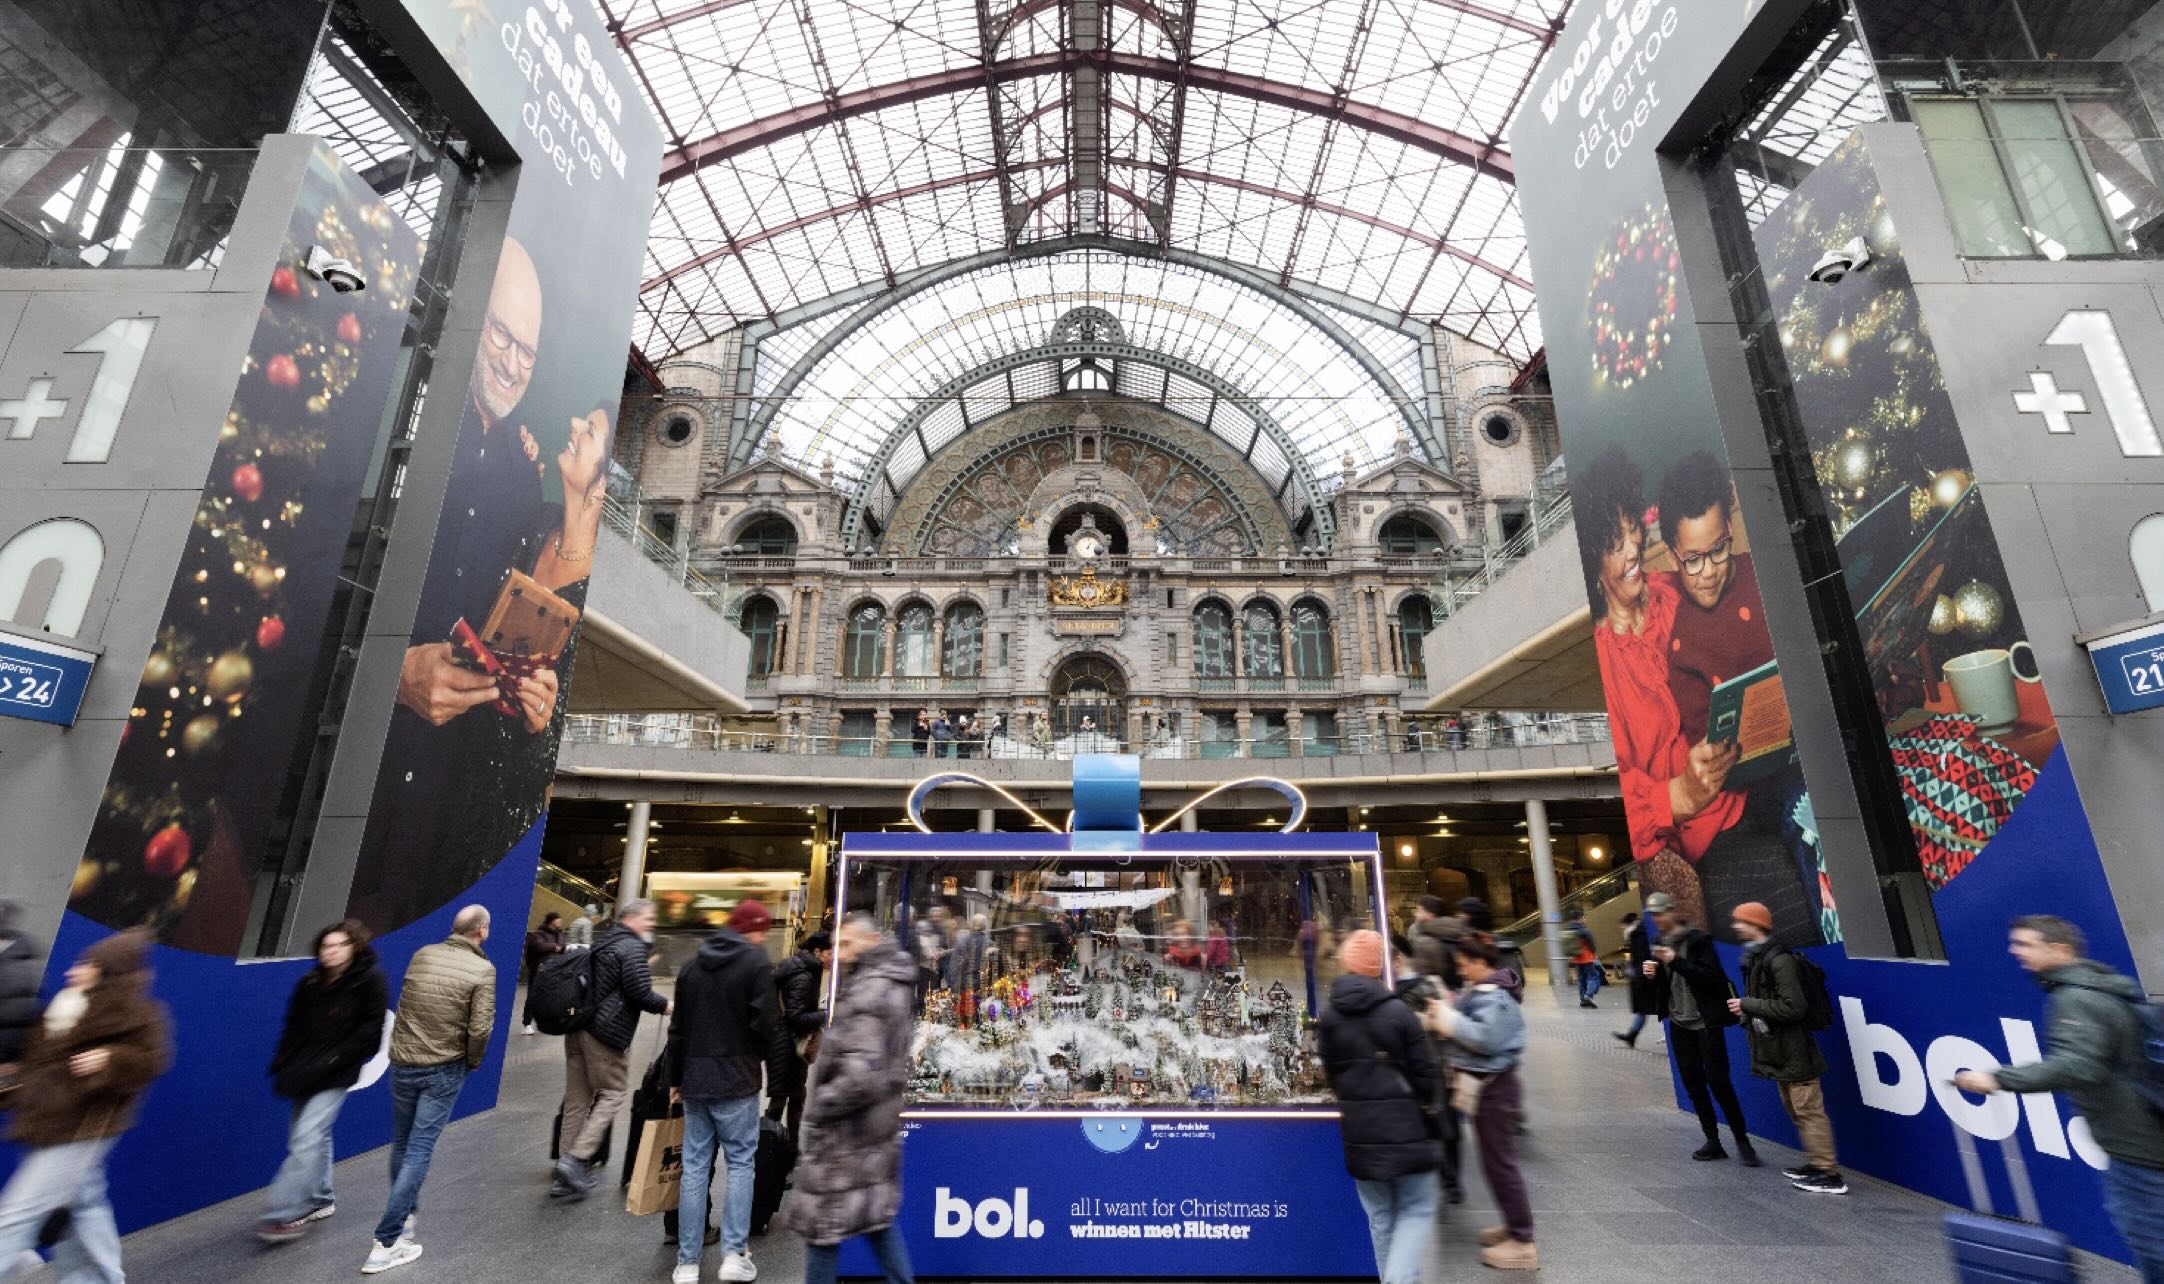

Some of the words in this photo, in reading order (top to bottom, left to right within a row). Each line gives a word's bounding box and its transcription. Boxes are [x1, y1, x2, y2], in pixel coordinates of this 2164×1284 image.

[501, 22, 544, 94] dat
[546, 91, 602, 181] ertoe
[526, 6, 628, 180] cadeau
[574, 33, 622, 125] een
[1541, 13, 1601, 125] voor
[1574, 107, 1611, 169] dat
[1612, 6, 1678, 111] ertoe
[523, 101, 577, 187] doet
[1605, 80, 1661, 169] doet
[0, 660, 33, 675] poren
[16, 677, 51, 703] 24
[2131, 664, 2164, 692] 21
[935, 1187, 1045, 1238] bol.
[1070, 1219, 1142, 1238] winnen
[1144, 1221, 1182, 1238] met
[1184, 1220, 1251, 1239] Hitster
[1071, 1198, 1091, 1216] all
[1095, 1198, 1101, 1216] I
[1104, 1200, 1148, 1216] want
[1152, 1198, 1175, 1216] for
[1180, 1198, 1270, 1218] Christmas
[1274, 1200, 1288, 1218] is
